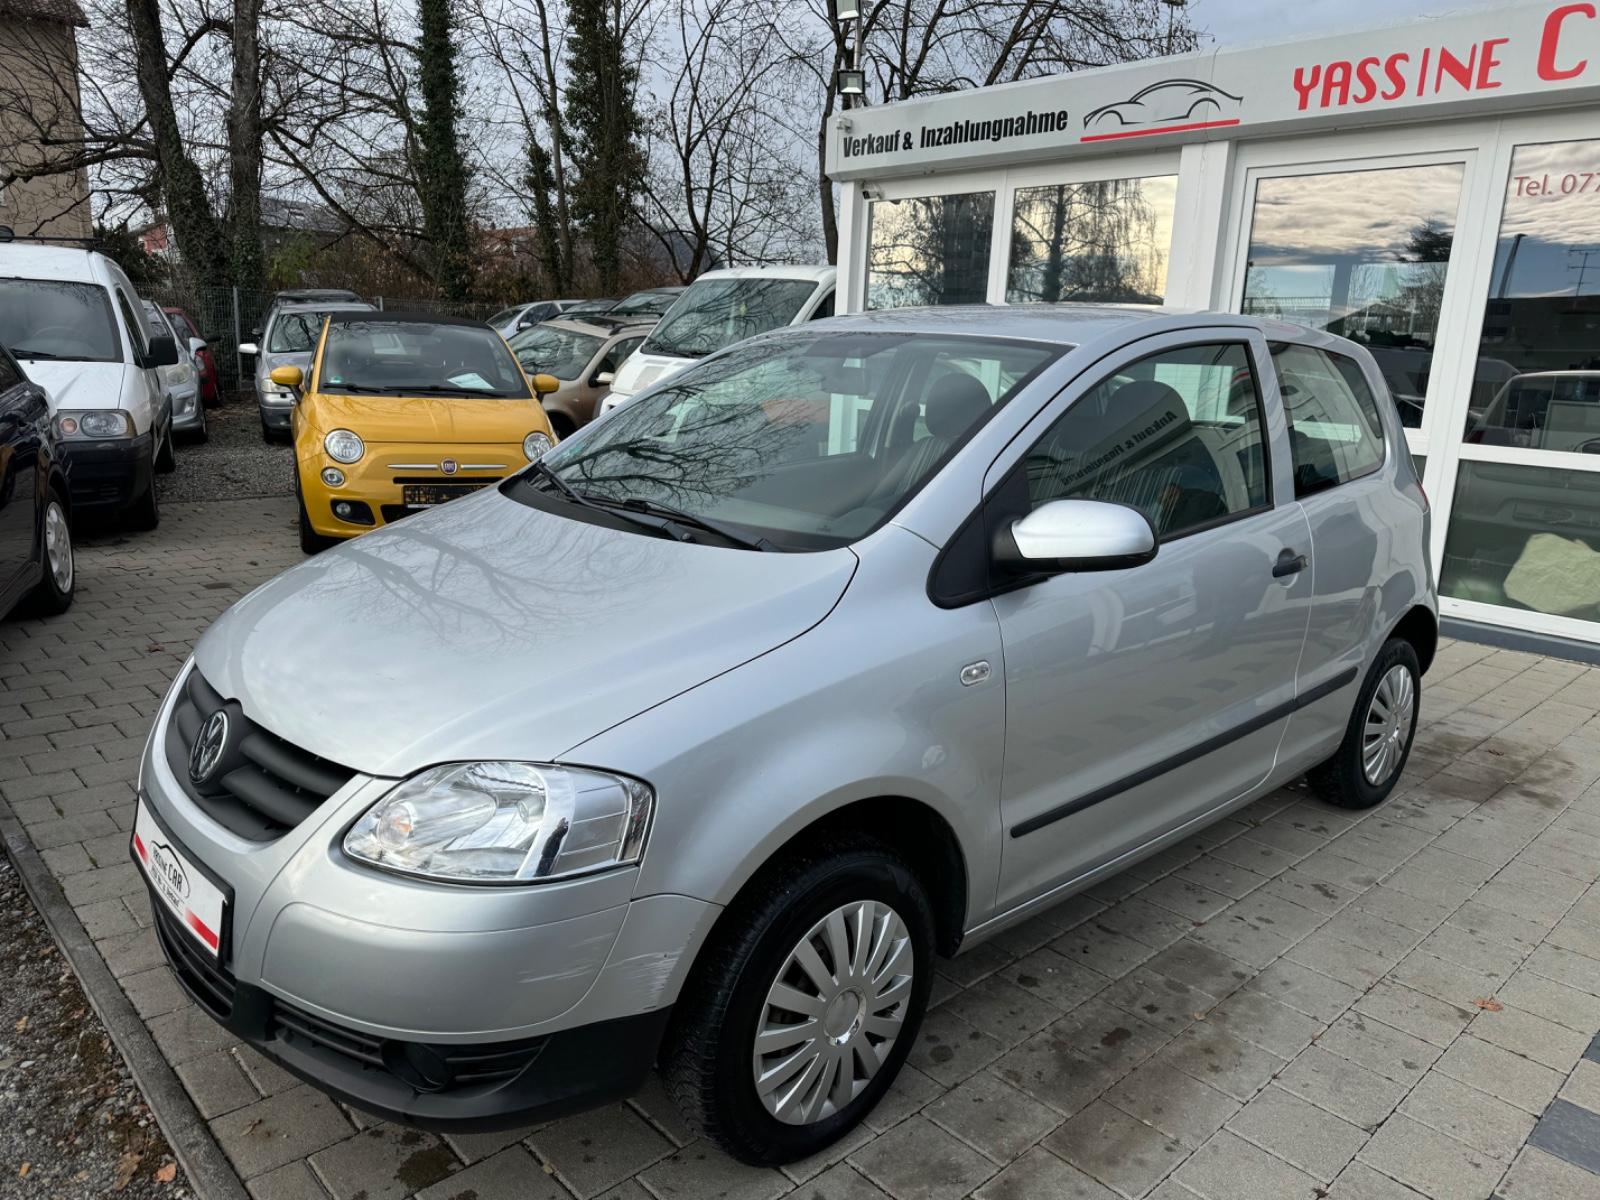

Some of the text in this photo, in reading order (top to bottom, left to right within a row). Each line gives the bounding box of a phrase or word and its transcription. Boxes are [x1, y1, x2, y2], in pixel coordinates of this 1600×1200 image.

[1293, 38, 1510, 110] YASSINE
[843, 110, 1069, 158] Verkauf & Inzahlungnahme
[1514, 173, 1553, 196] Tel.
